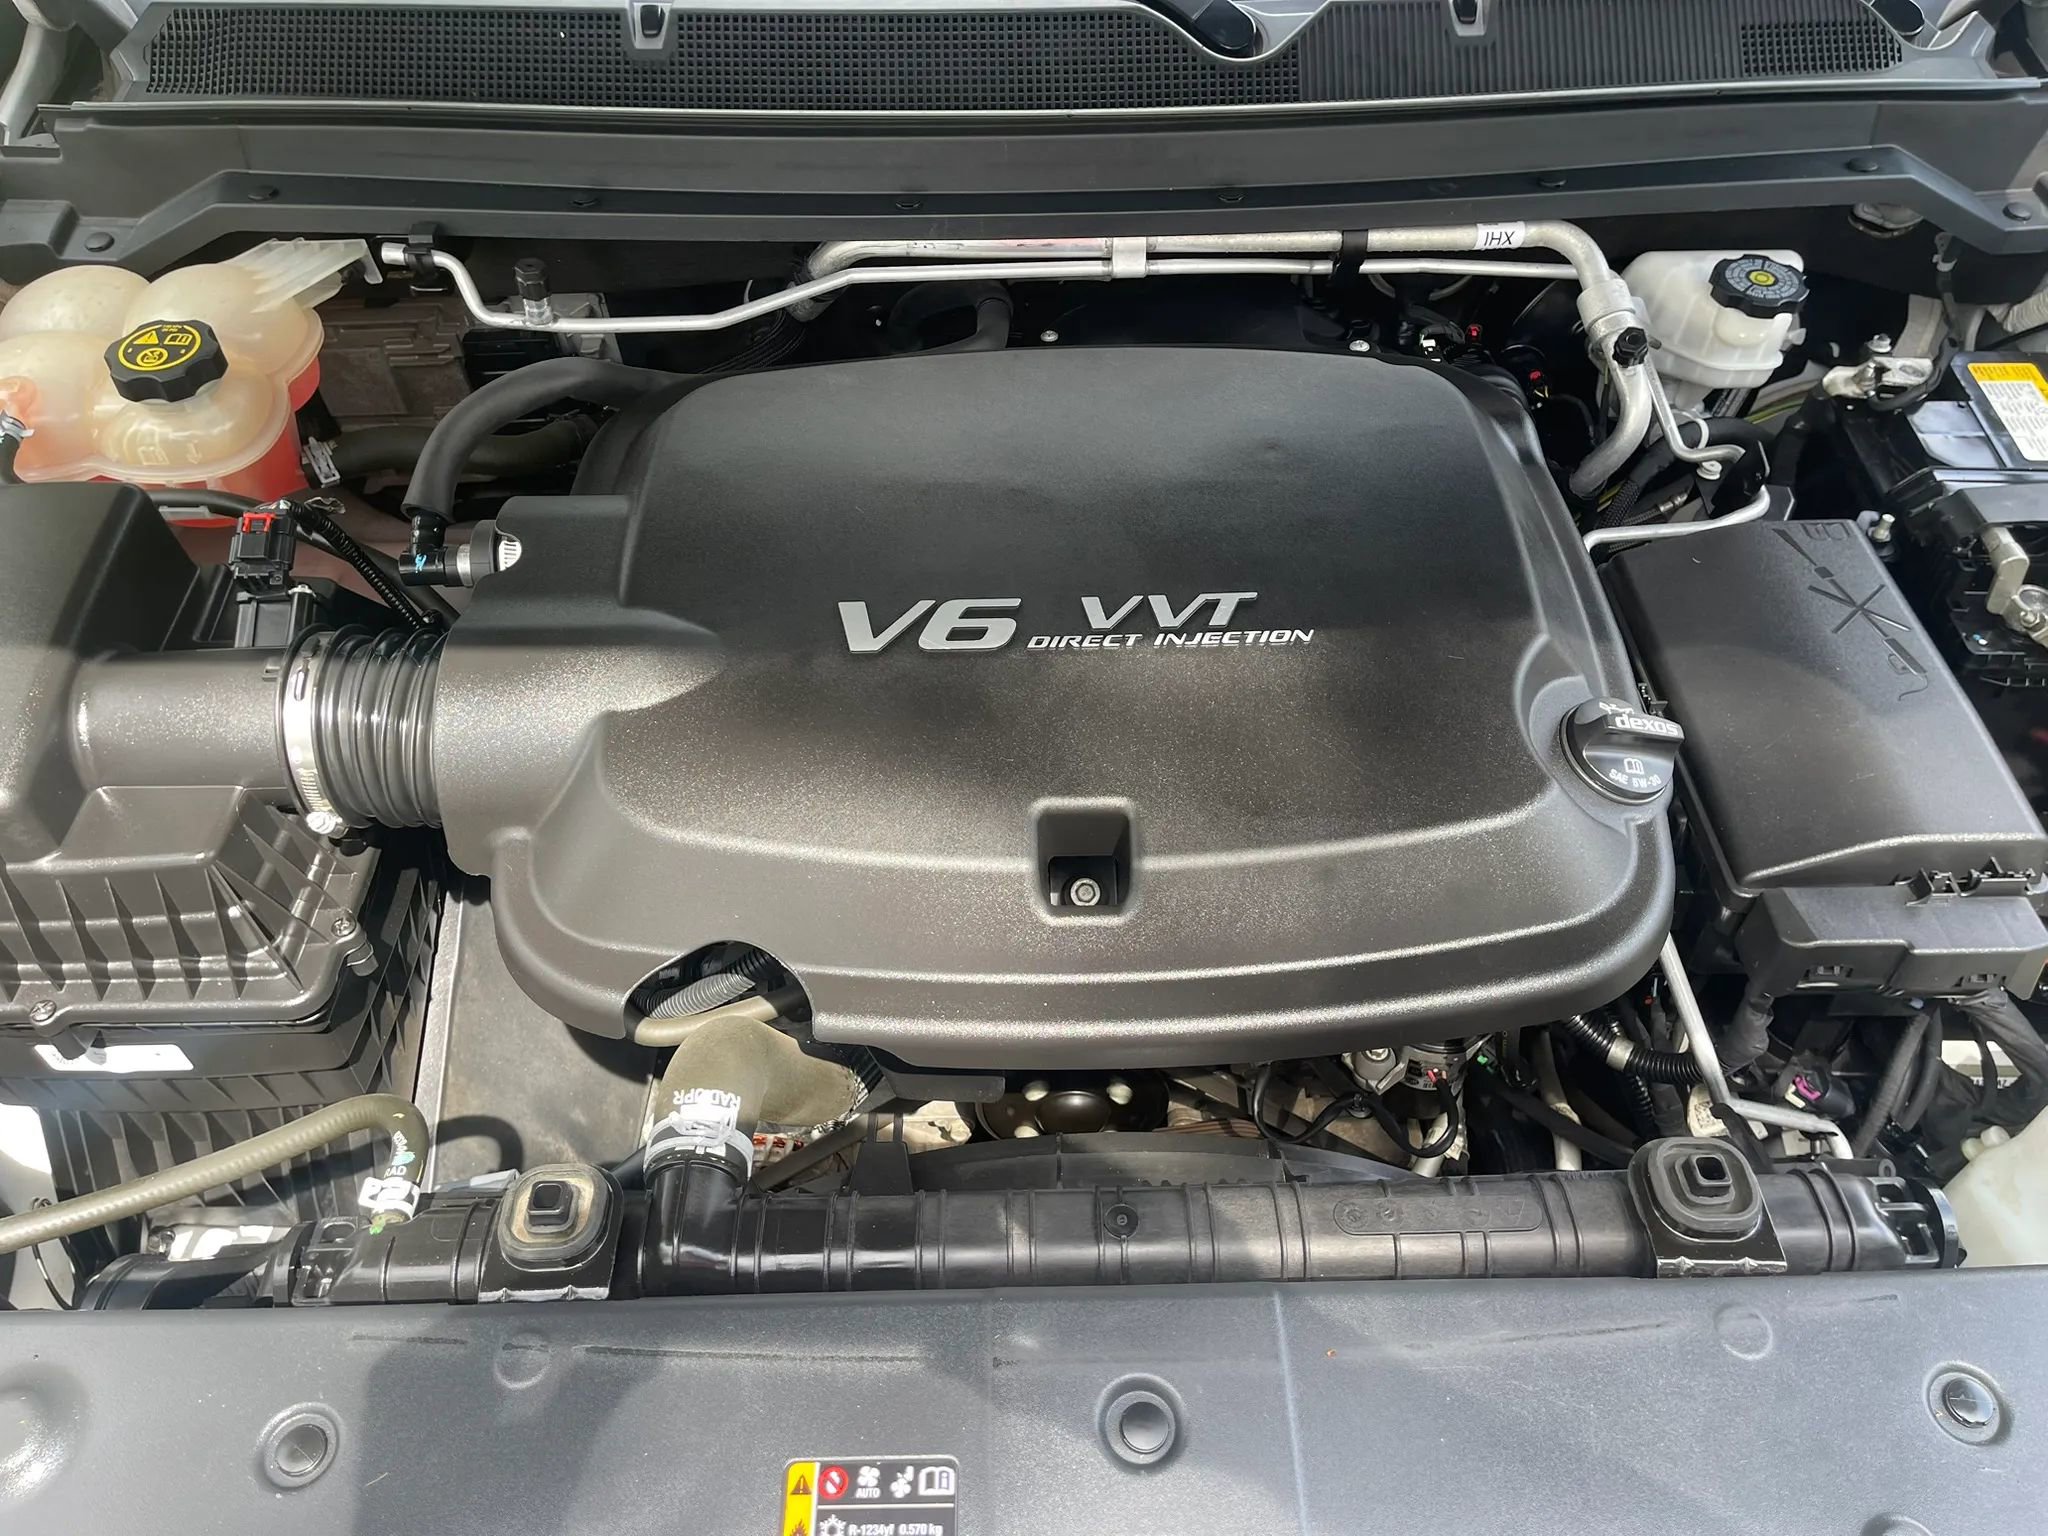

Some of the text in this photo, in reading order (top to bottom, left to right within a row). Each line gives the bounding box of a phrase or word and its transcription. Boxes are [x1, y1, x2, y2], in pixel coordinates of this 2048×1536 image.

[1081, 592, 1258, 630] VVT
[838, 598, 1021, 653] V6
[1026, 629, 1315, 649] DIRECT INJECTION
[1615, 714, 1679, 736] dexos
[1609, 768, 1629, 785] SAE
[855, 1487, 881, 1498] AUTO
